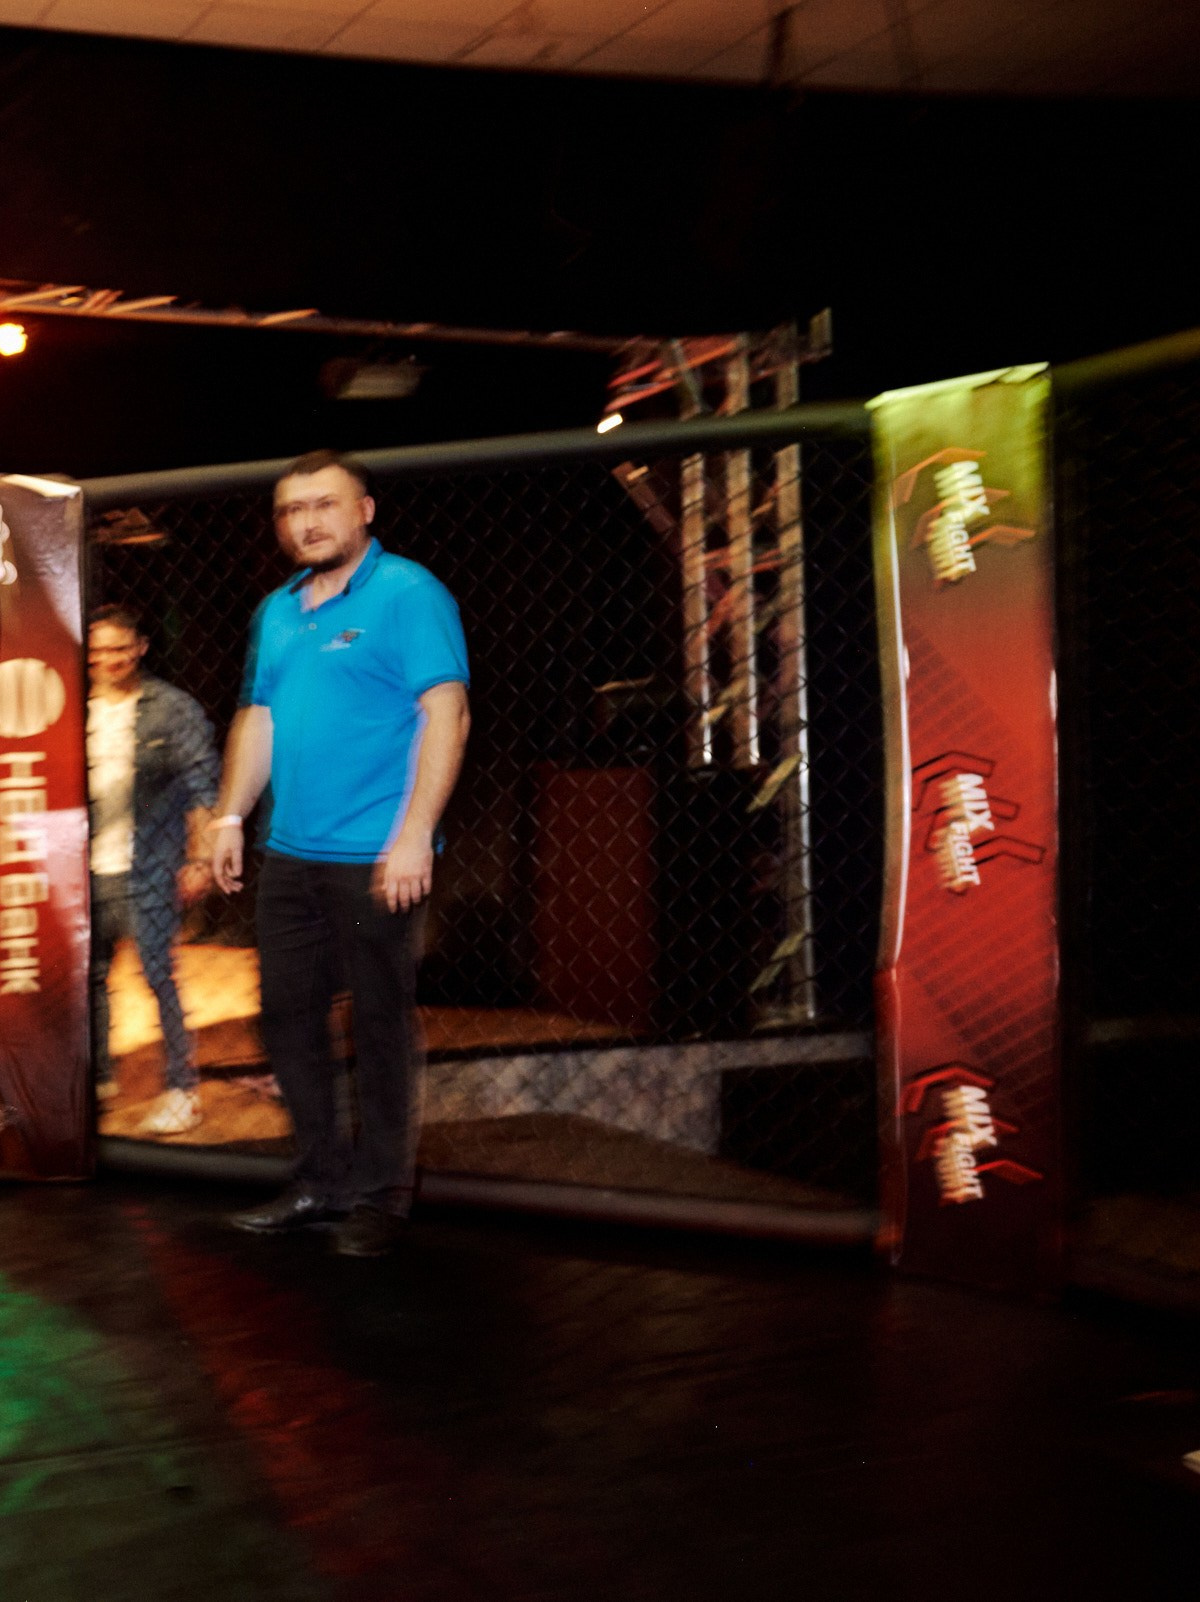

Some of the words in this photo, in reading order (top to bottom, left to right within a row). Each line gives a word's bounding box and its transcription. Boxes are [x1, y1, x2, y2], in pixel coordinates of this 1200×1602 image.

[946, 460, 990, 519] MIX
[940, 511, 977, 575] FIGHT
[951, 773, 995, 831] MIX
[945, 821, 981, 886] FIGHT
[955, 1085, 998, 1146] MIX
[947, 1133, 984, 1199] FIGHT
